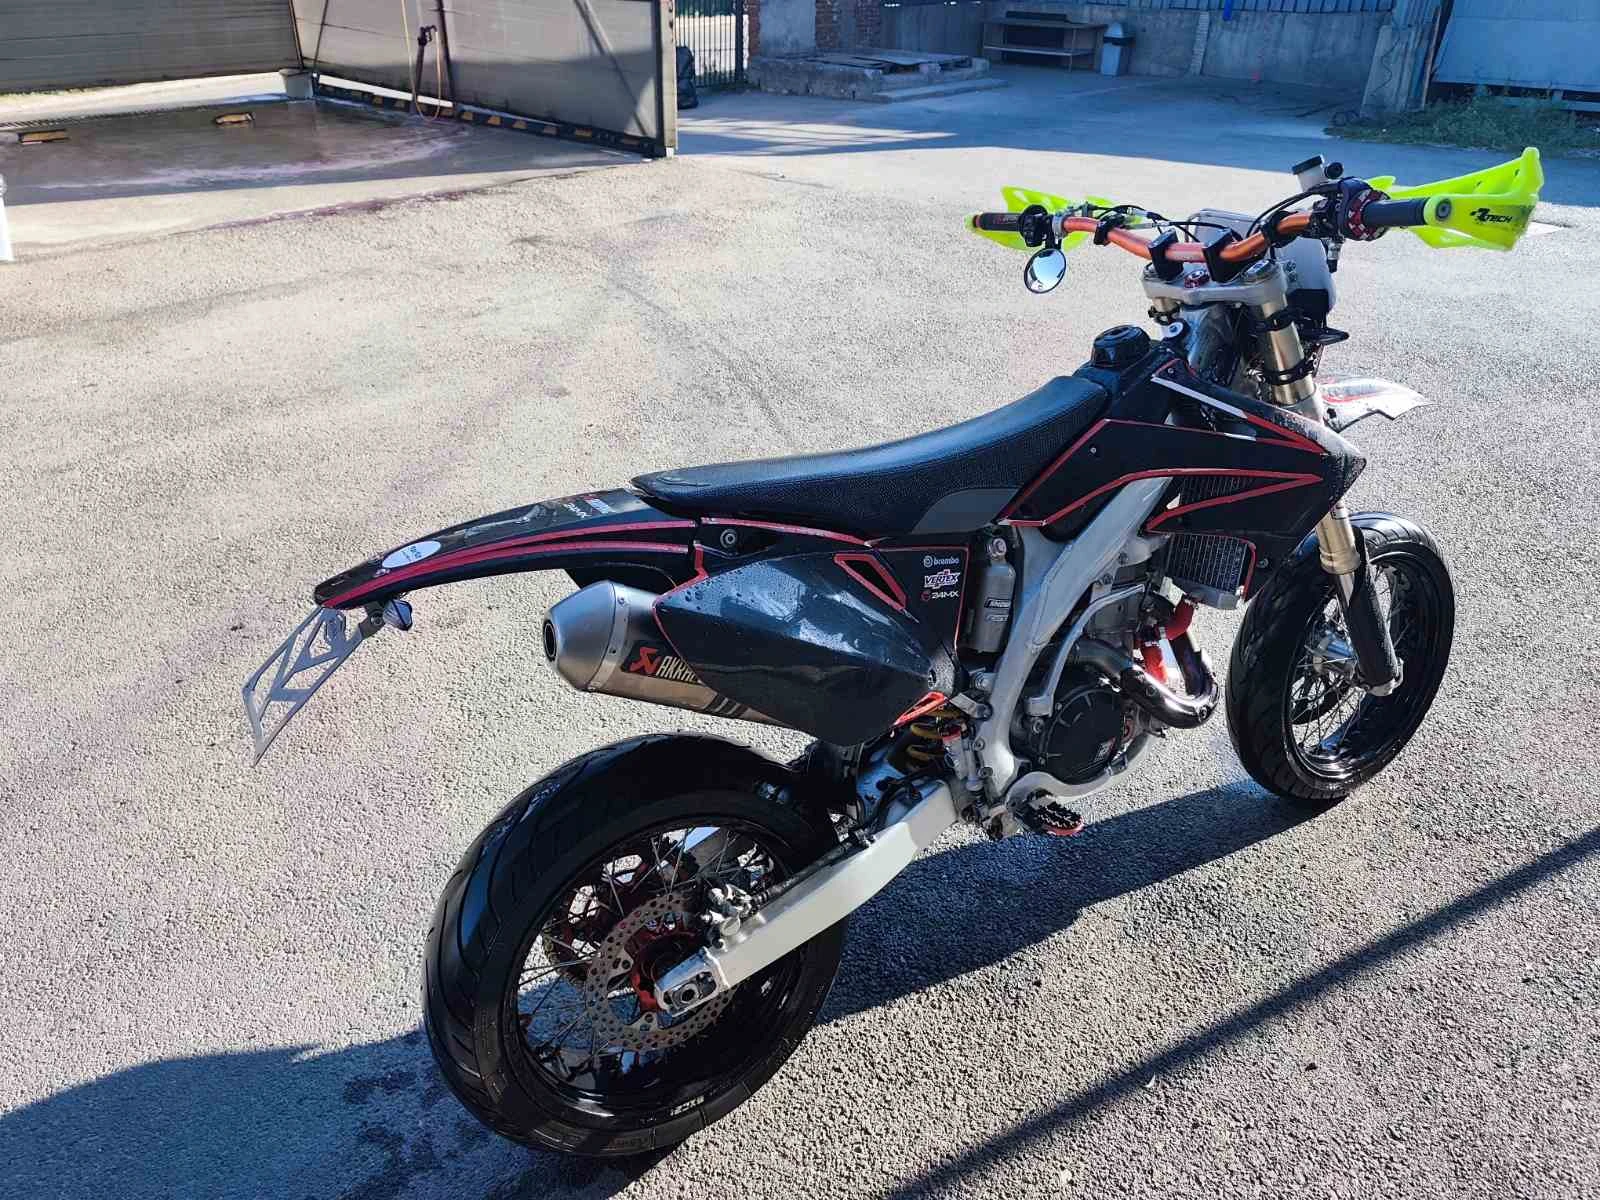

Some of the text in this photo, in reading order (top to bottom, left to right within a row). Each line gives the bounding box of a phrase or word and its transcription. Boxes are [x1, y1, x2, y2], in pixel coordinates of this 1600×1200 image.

[933, 556, 960, 566] brembo
[926, 573, 959, 586] VERTEX
[931, 590, 960, 599] 24MX
